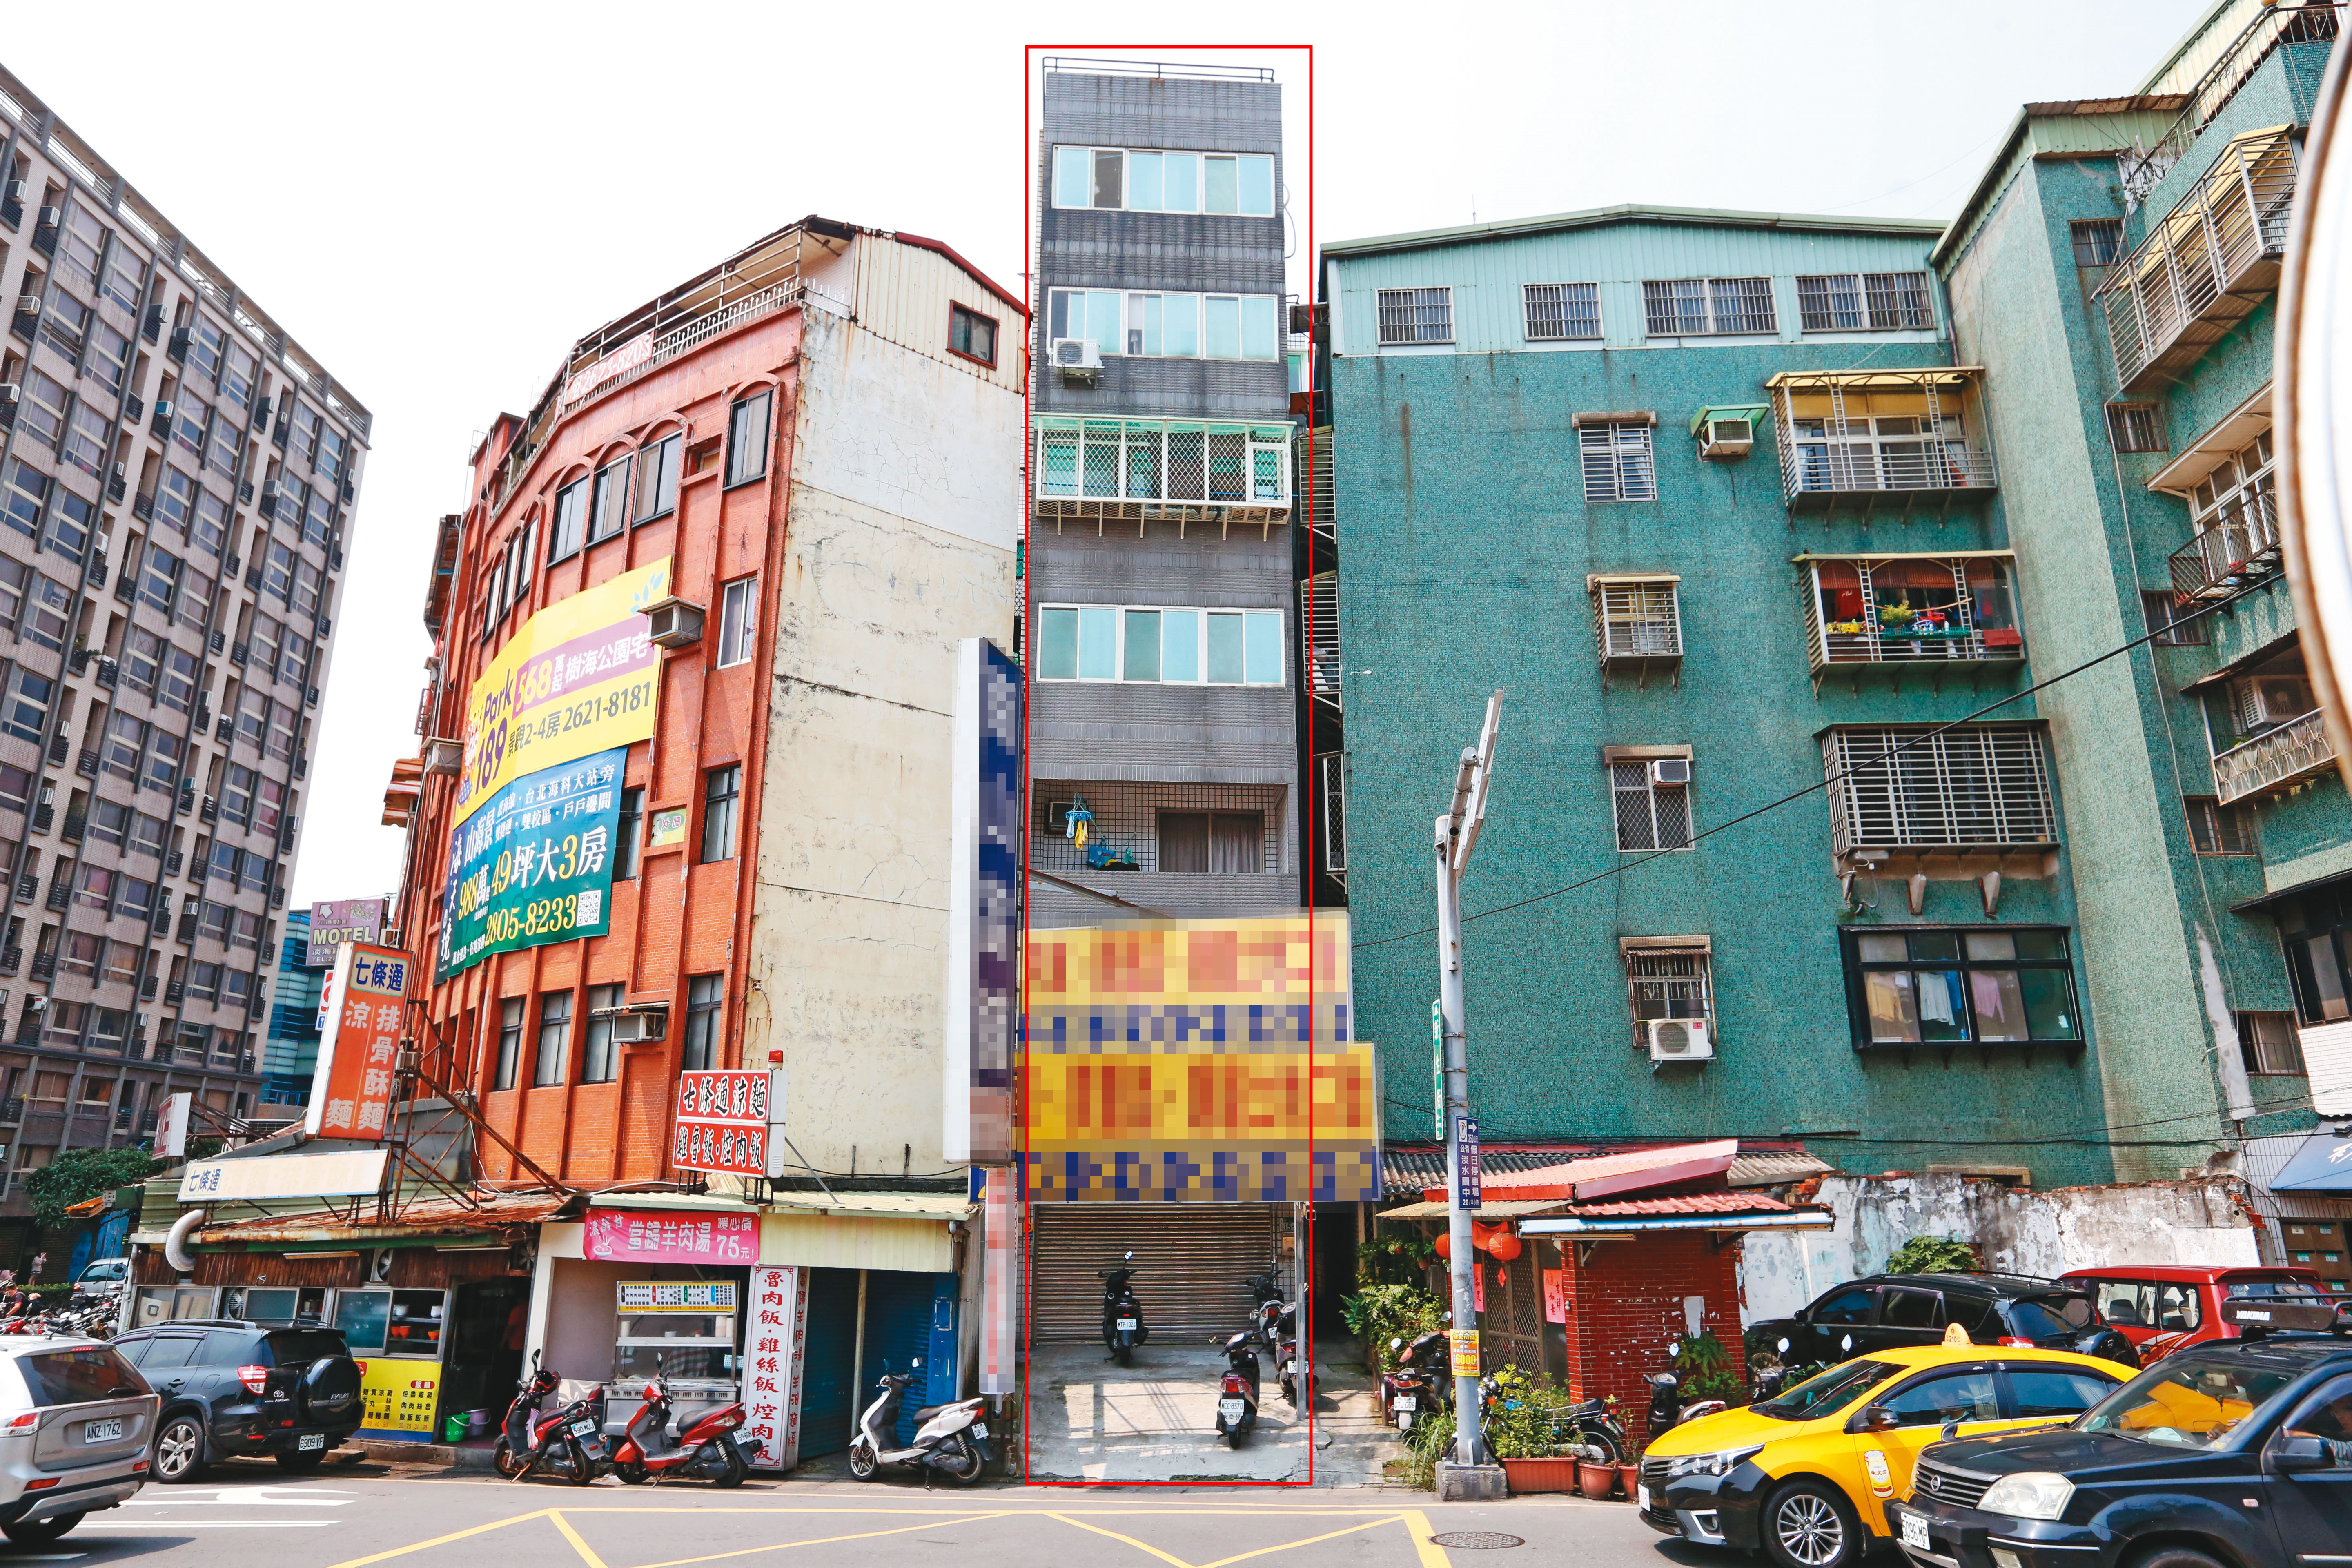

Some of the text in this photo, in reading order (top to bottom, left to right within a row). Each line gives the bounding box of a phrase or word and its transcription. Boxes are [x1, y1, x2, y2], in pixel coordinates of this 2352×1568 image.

[515, 659, 552, 712] 568
[564, 631, 650, 682] 樹海公園宅
[482, 667, 514, 733] Park
[563, 681, 651, 733] 2621-8181
[475, 717, 508, 795] 189
[312, 926, 374, 946] MOTEL
[484, 894, 577, 947] 2805-8233
[355, 956, 404, 993] 七條通
[325, 1000, 371, 1129] 涼麵
[357, 1003, 401, 1131] 排骨酥麵
[189, 1168, 222, 1193] 七條通
[1461, 1155, 1470, 1197] 淡水國中
[1471, 1145, 1479, 1197] 假日停車場
[628, 1220, 712, 1254] 當歸羊肉湯
[717, 1216, 753, 1232] 暖心價
[2236, 1310, 2271, 1321] YAKIMA
[1455, 1354, 1477, 1365] 6000
[87, 1422, 121, 1440] ANZ-1762
[1902, 1519, 1927, 1545] 5096-MP
